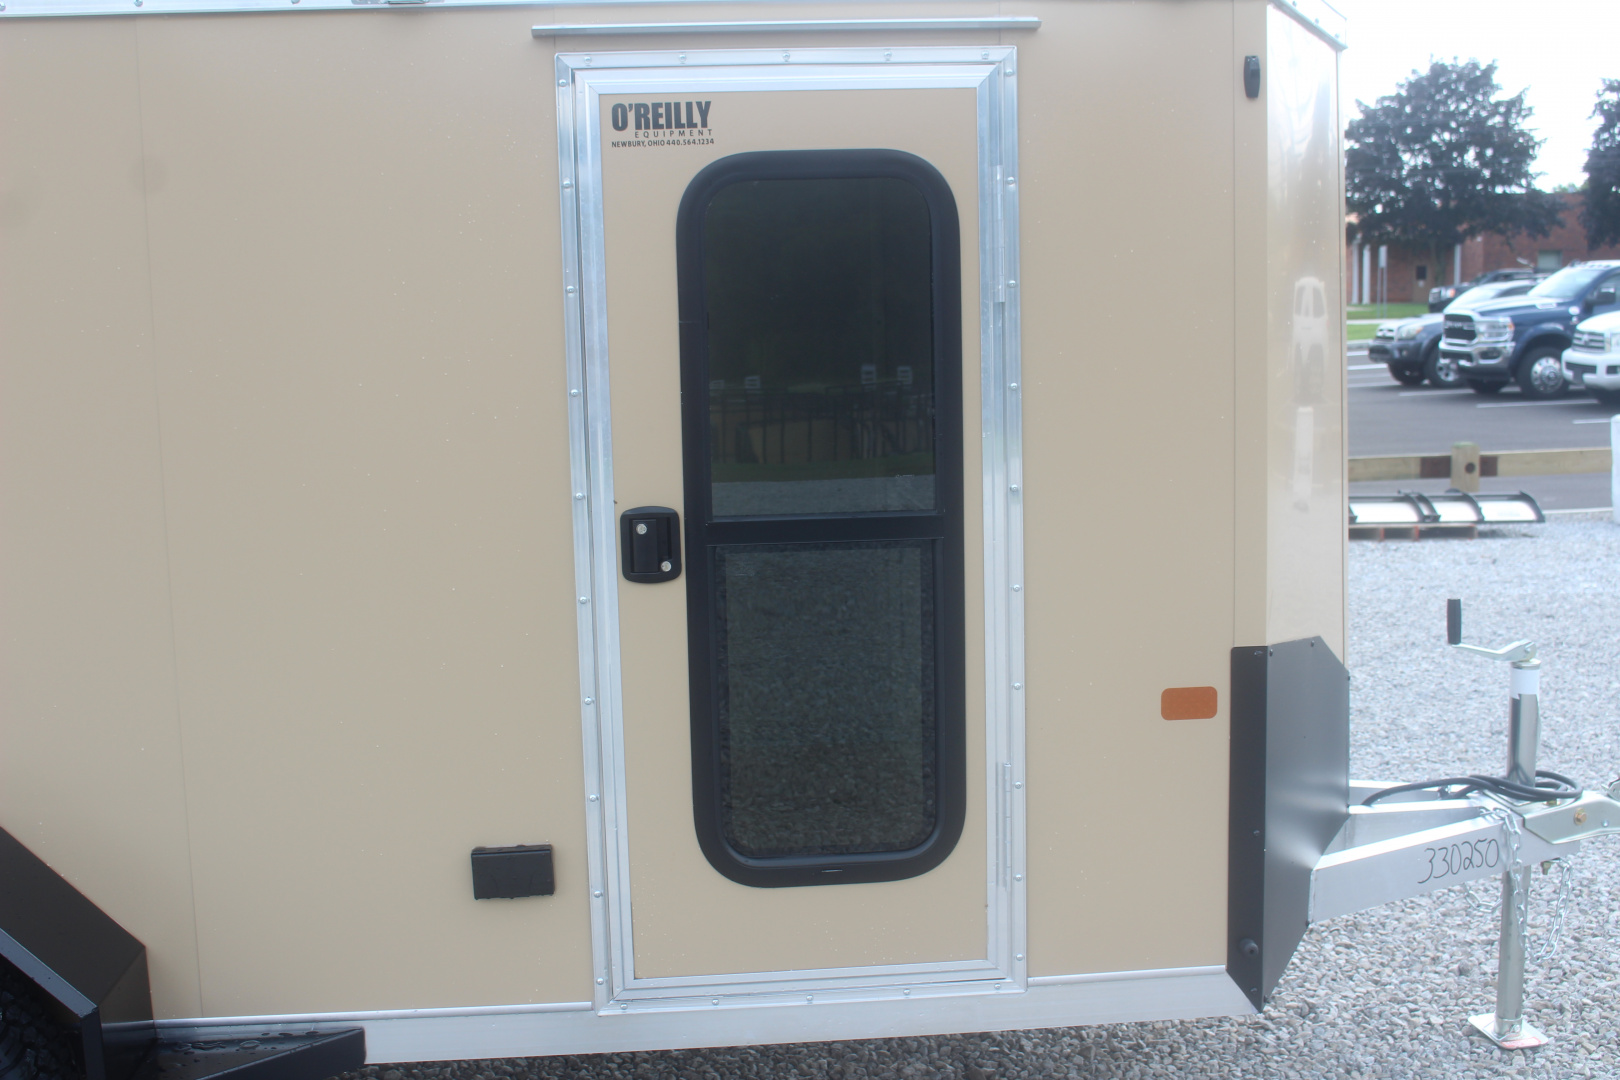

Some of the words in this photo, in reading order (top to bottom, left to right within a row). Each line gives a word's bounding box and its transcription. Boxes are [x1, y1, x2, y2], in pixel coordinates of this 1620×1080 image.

[611, 101, 712, 132] O'REILLY
[611, 140, 646, 148] NEWBURY,
[647, 139, 665, 147] OHIO
[666, 138, 714, 146] 440.564.1234
[634, 129, 712, 138] EQUIPMENT
[1417, 838, 1499, 884] 330250
